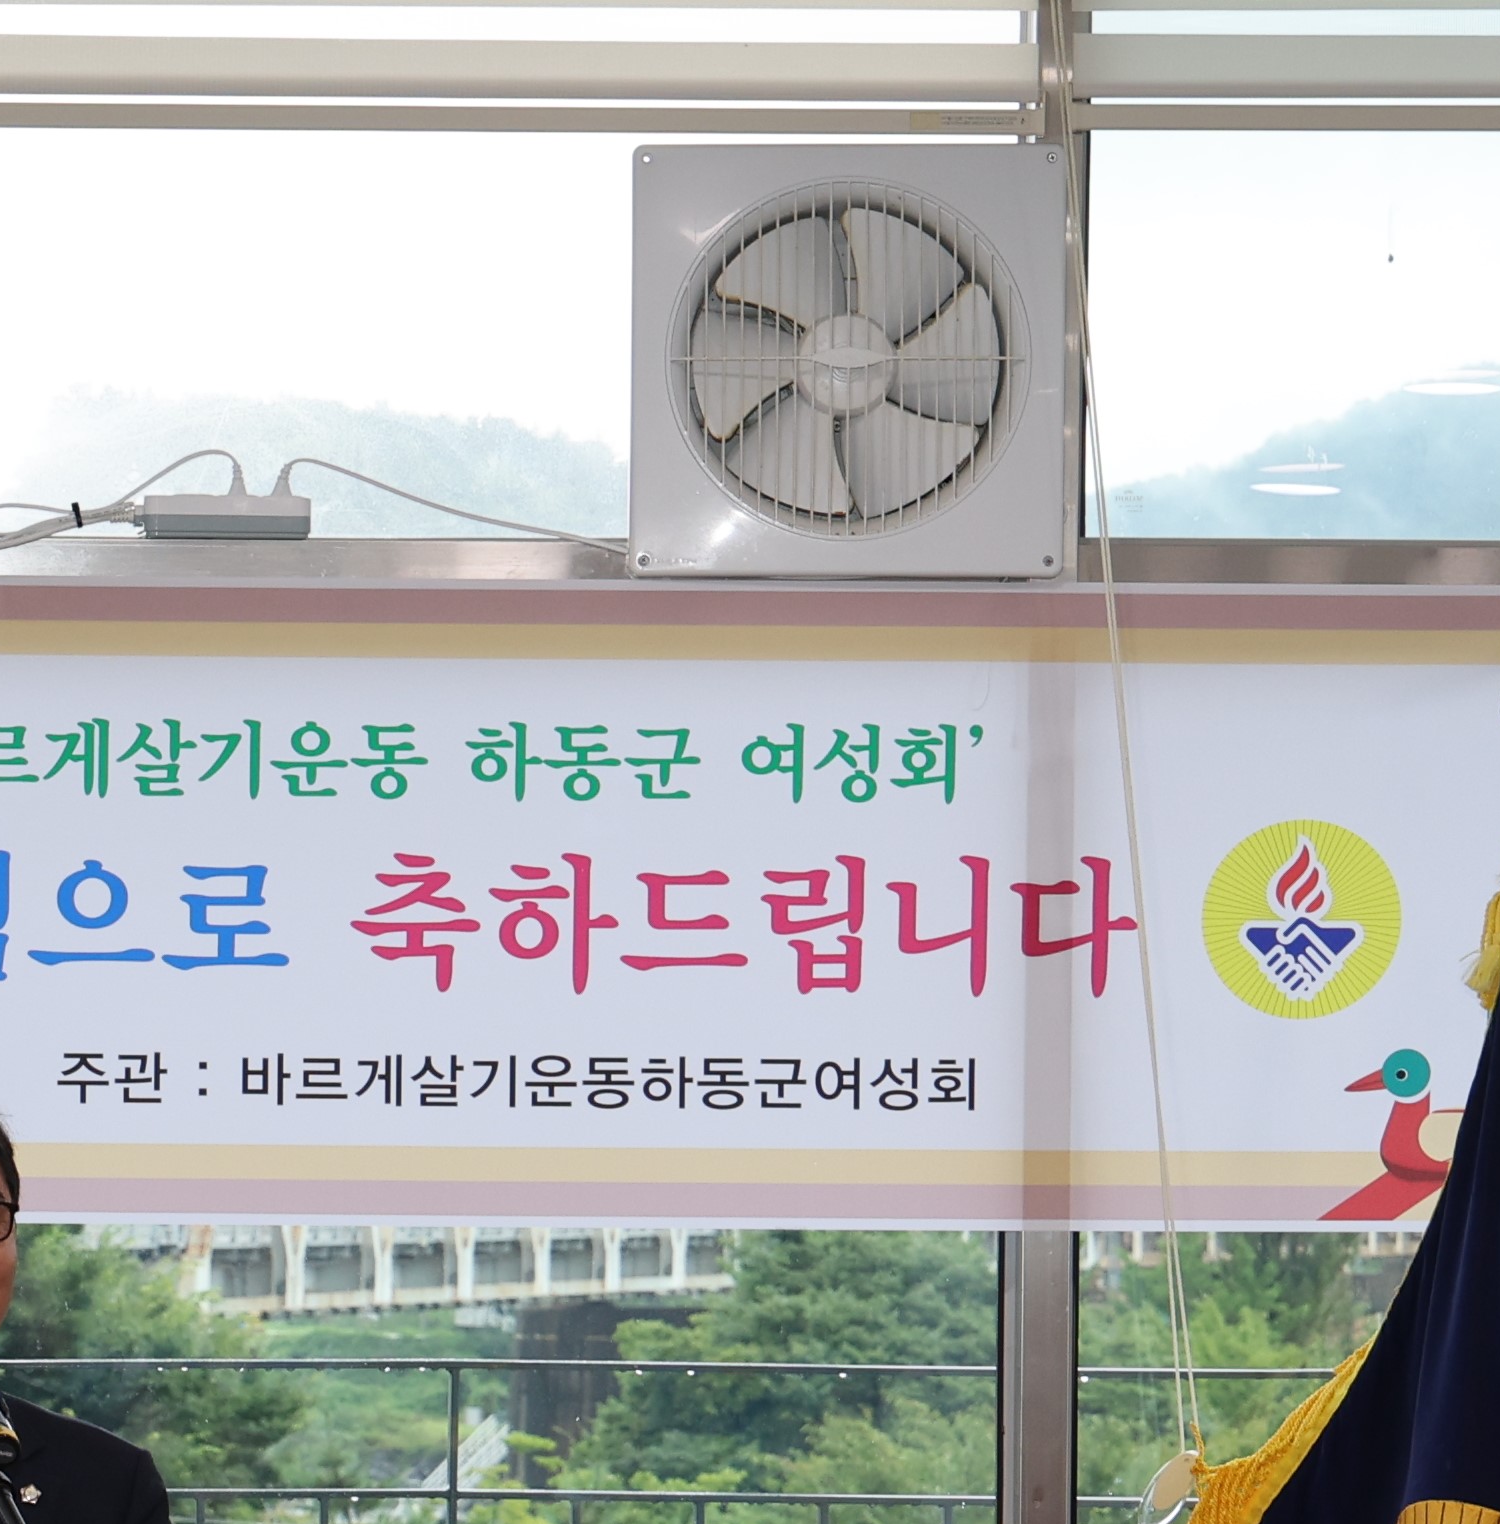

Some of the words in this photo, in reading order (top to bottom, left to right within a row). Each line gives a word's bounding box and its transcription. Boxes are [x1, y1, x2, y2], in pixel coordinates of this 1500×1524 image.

[467, 721, 699, 802] 하동군
[351, 852, 1139, 998] 축하드립니다
[56, 1051, 169, 1105] 주관
[241, 1052, 979, 1112] 바르게살기운동하동군여성회
